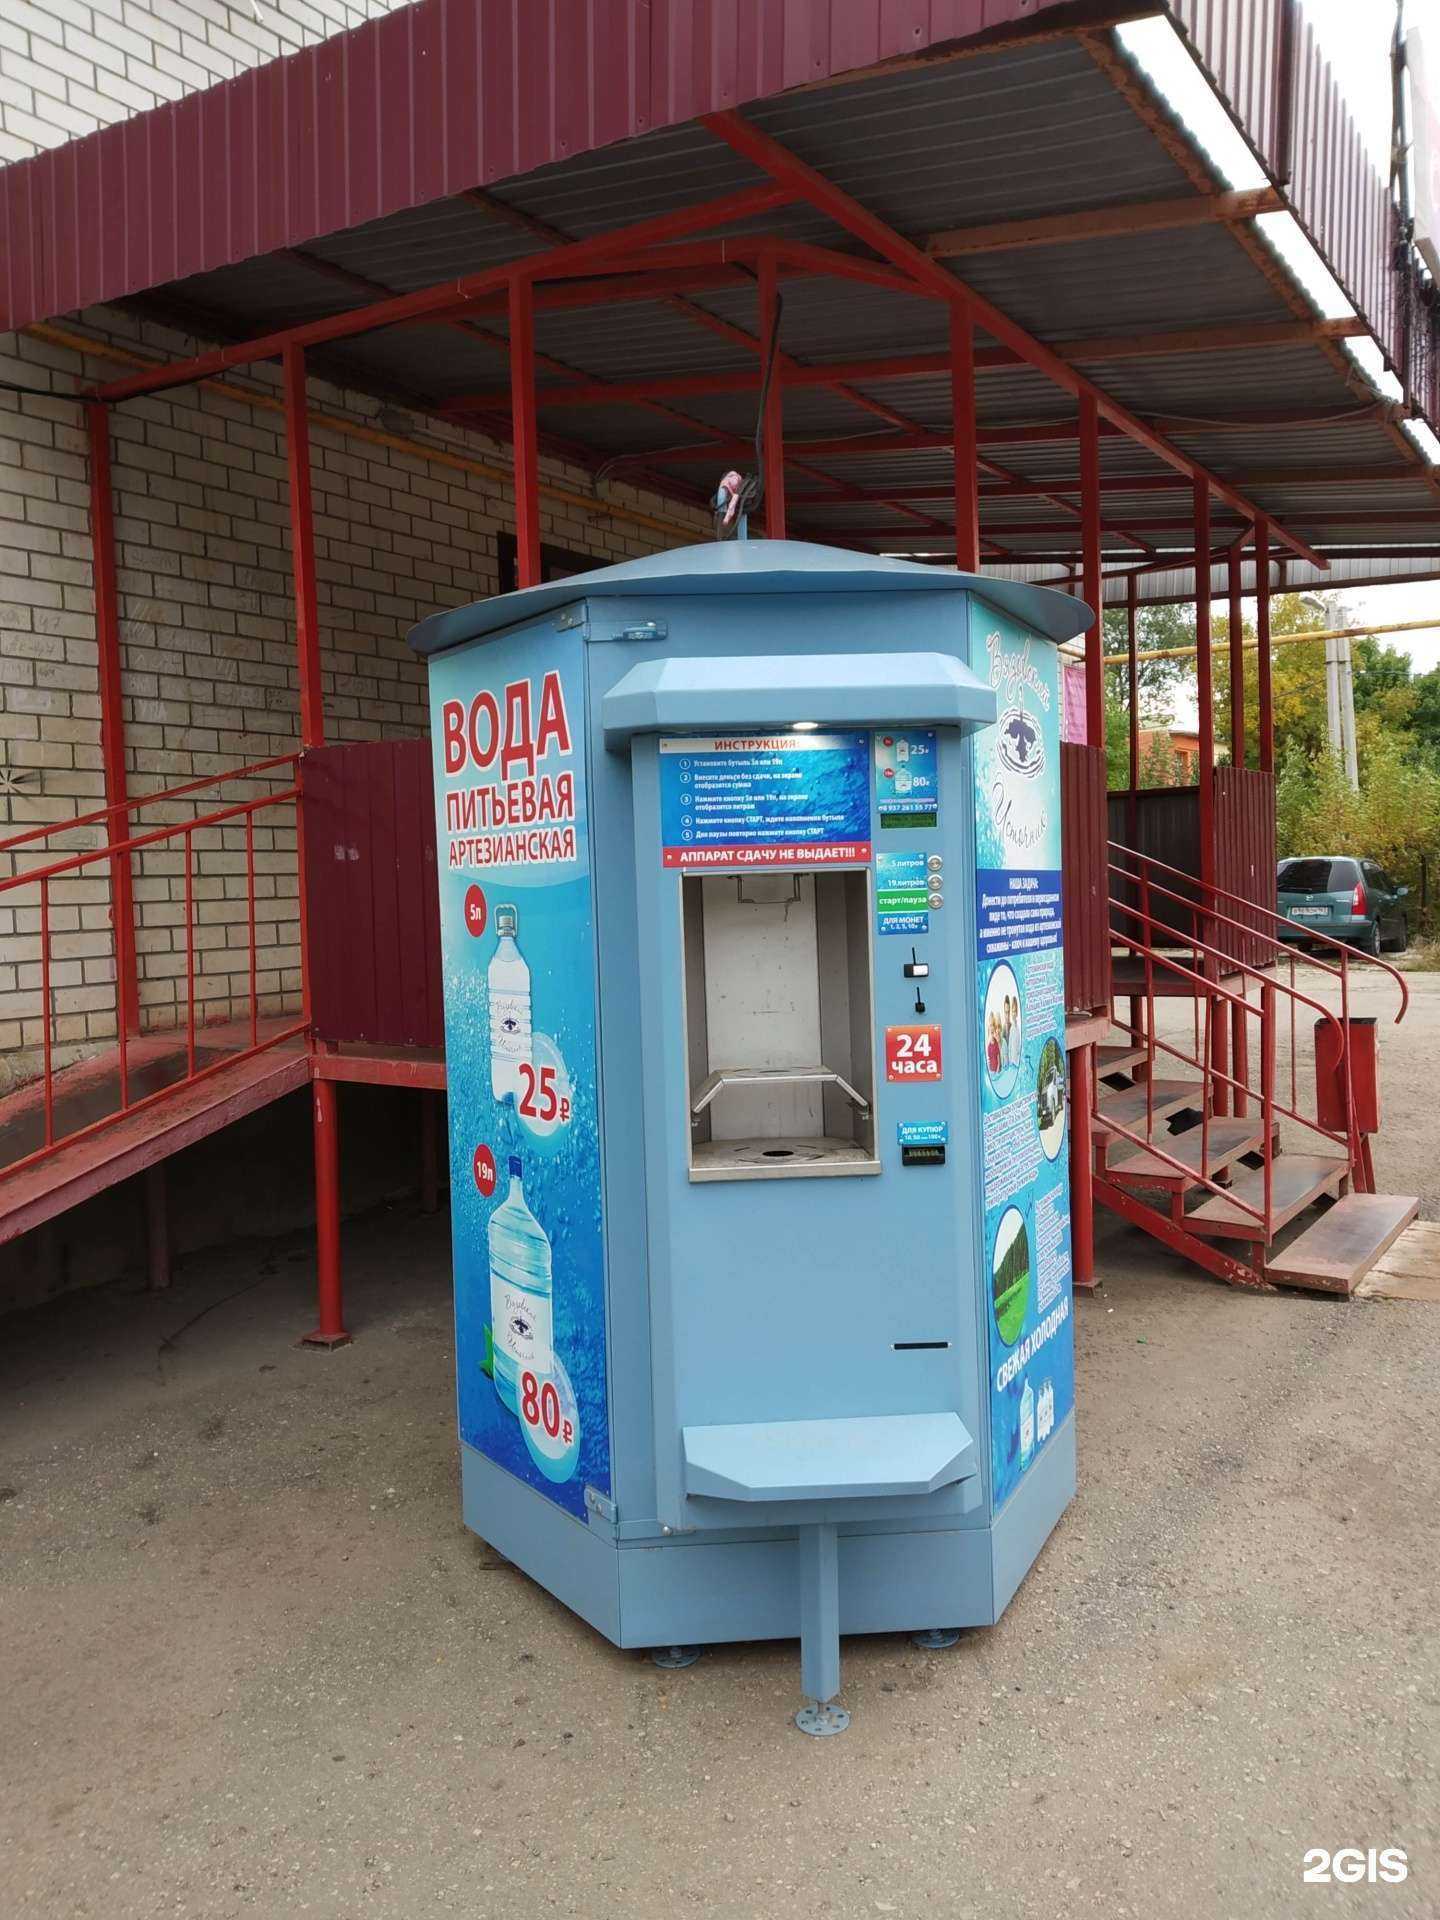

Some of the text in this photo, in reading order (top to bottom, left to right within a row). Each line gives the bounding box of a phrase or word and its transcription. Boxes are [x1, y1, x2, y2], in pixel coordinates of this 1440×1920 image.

[442, 670, 572, 782] ВОДА
[741, 772, 751, 780] без
[446, 771, 575, 833] ПИТЬЕВАЯ
[448, 827, 576, 869] АРТЕЗИАНСКАЯ
[680, 847, 856, 863] АППАРАТ СДАЧУ НЕ ВЫДАЕТ!!!
[897, 860, 925, 868] литров
[879, 896, 927, 906] старт/пауза
[469, 903, 482, 921] 5л
[898, 916, 924, 924] МОНЕТ
[896, 1033, 932, 1058] 24
[891, 1059, 938, 1075] часа
[902, 1125, 944, 1135] ДЛЯ КУПЮР
[476, 1160, 494, 1183] 19л
[996, 1337, 1031, 1393] СВЕЖАЯ
[1030, 1295, 1069, 1356] ХОЛОДНАЯ
